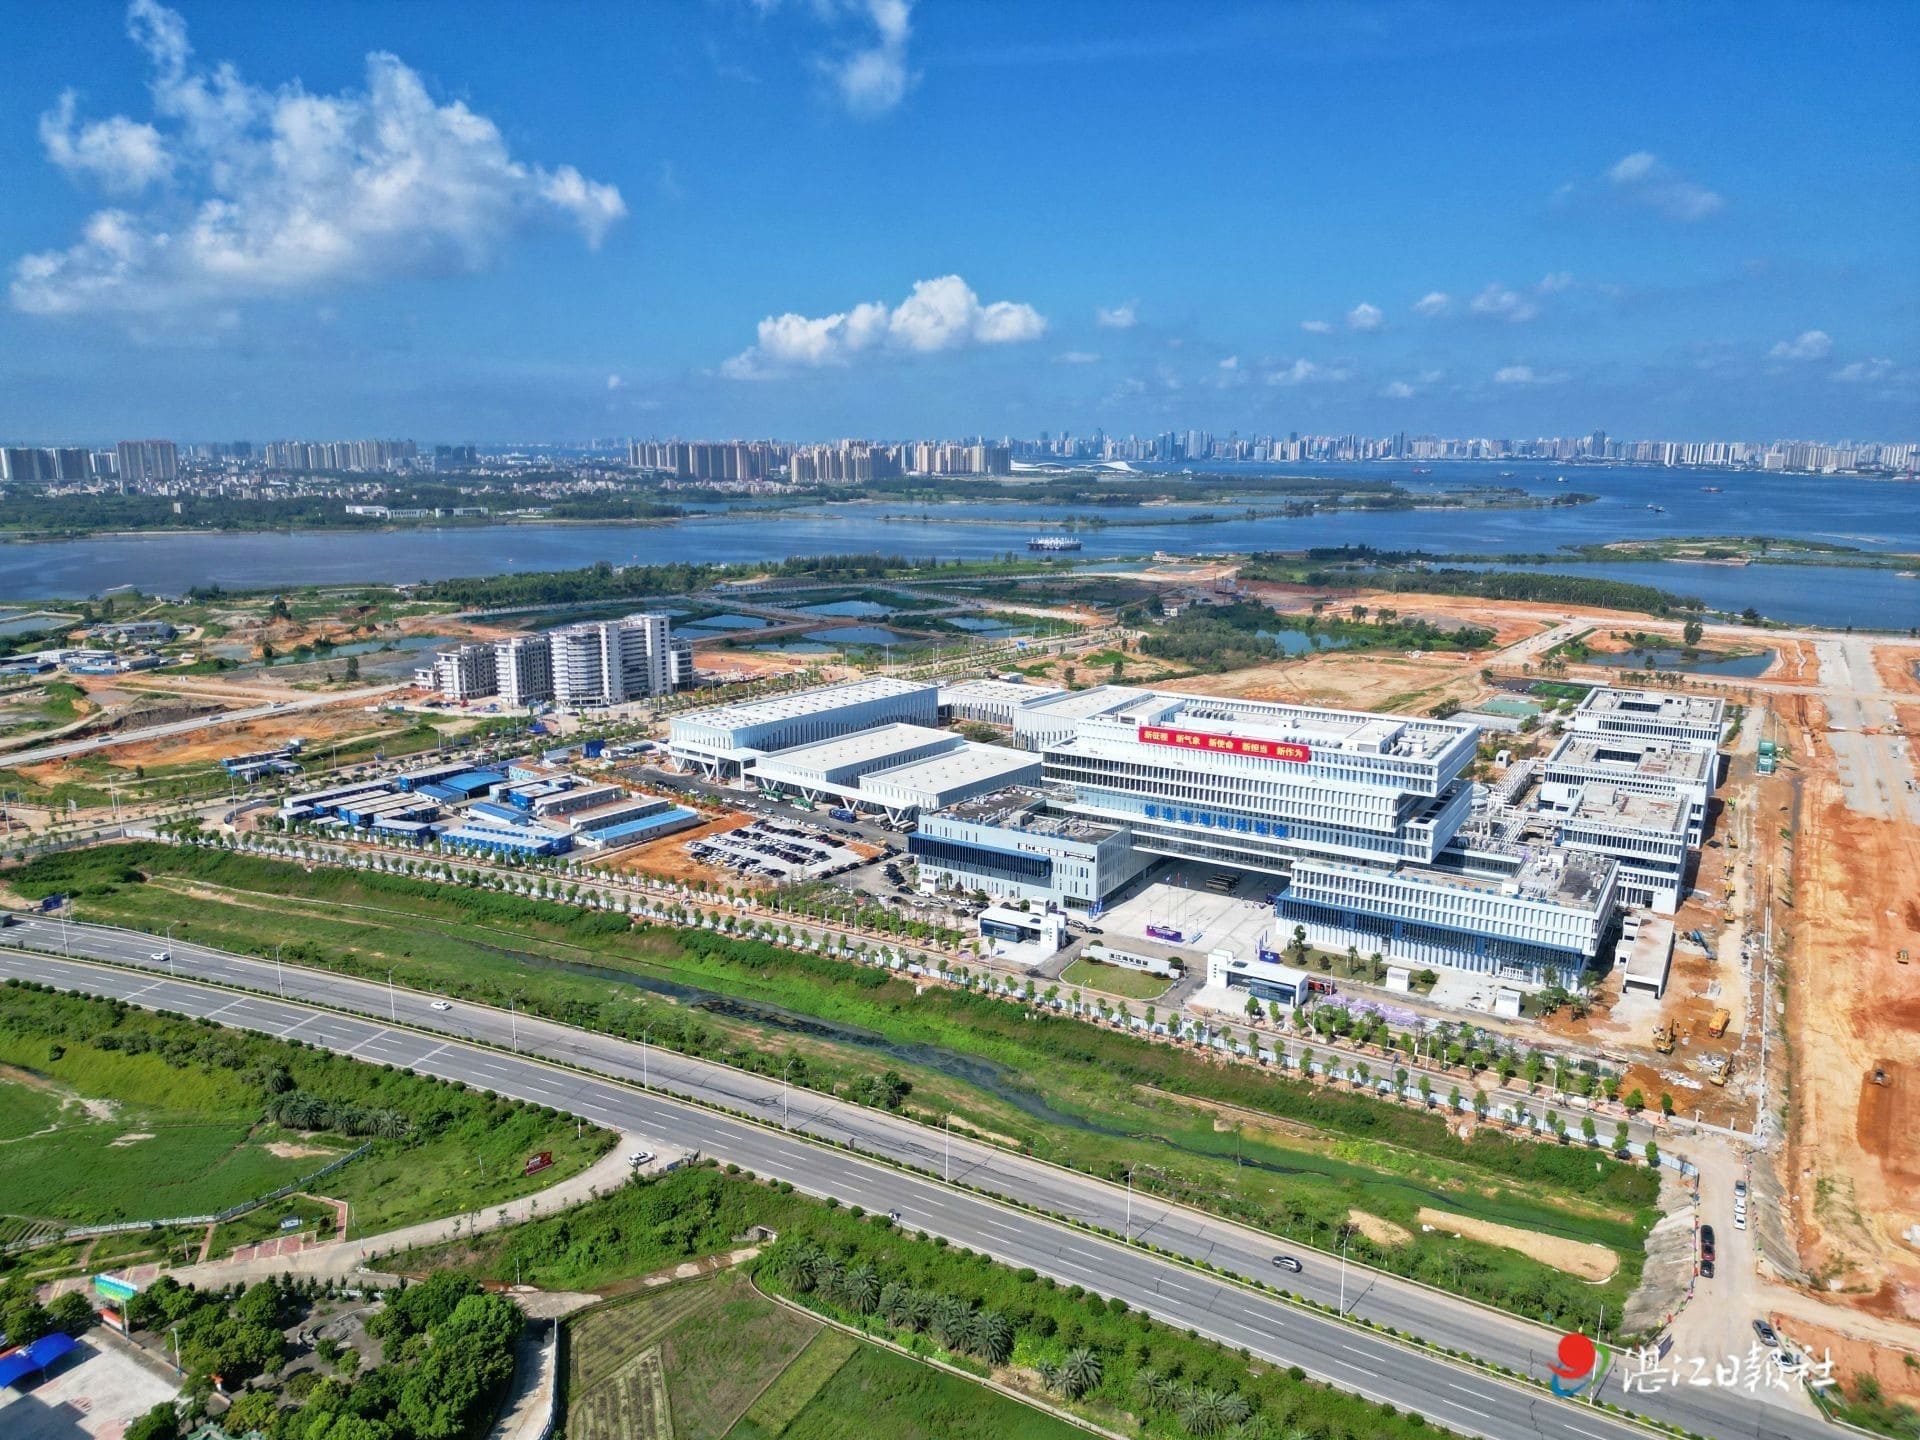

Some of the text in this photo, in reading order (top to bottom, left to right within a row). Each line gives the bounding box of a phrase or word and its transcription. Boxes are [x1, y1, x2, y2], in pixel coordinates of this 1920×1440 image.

[1144, 730, 1303, 758] 新征程 新气象 新使命 新担当 新作为
